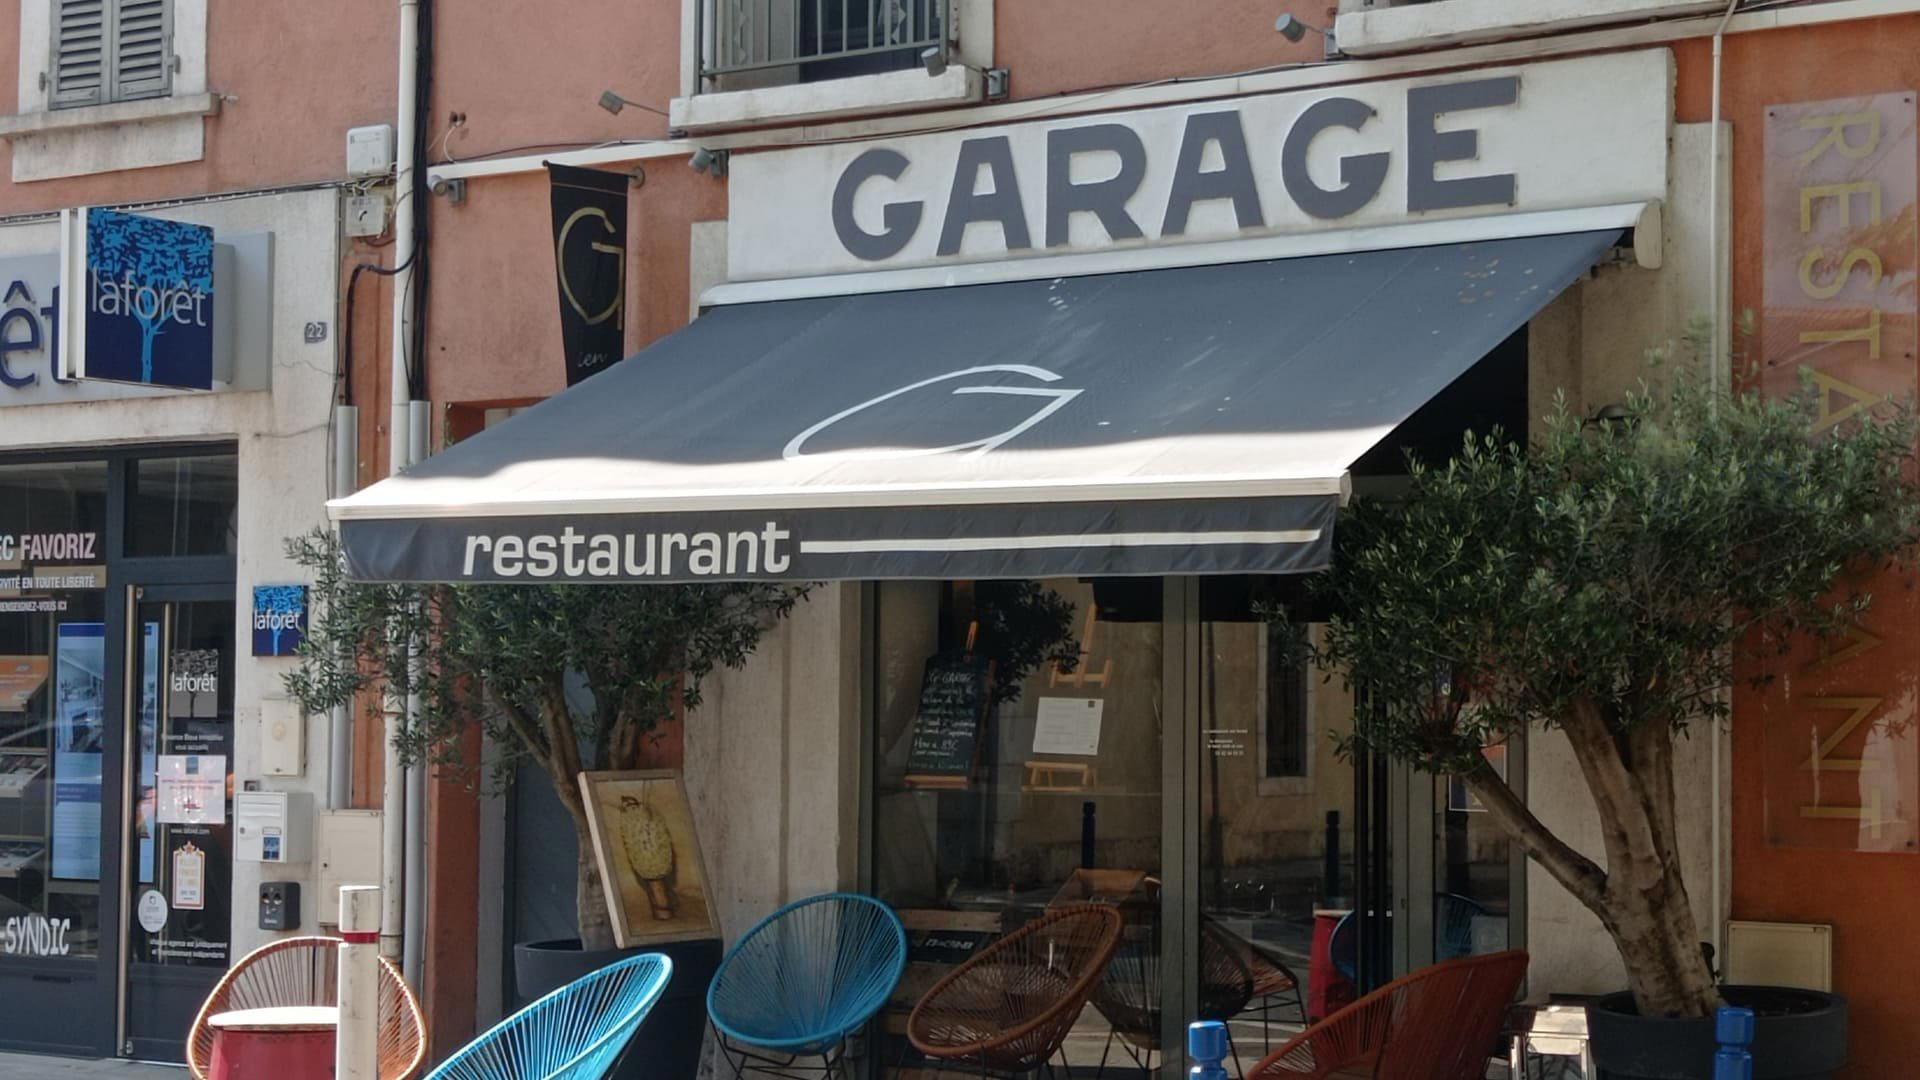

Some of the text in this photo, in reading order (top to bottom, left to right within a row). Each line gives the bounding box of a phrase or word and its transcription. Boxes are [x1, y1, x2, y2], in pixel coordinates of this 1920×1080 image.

[832, 76, 1520, 260] GARAGE
[92, 267, 206, 327] laforêt
[1798, 111, 1883, 840] RESTAANT
[20, 532, 96, 561] FAVORIZ
[462, 521, 791, 577] restaurant
[254, 609, 301, 630] laforêt
[171, 671, 216, 692] laforêt
